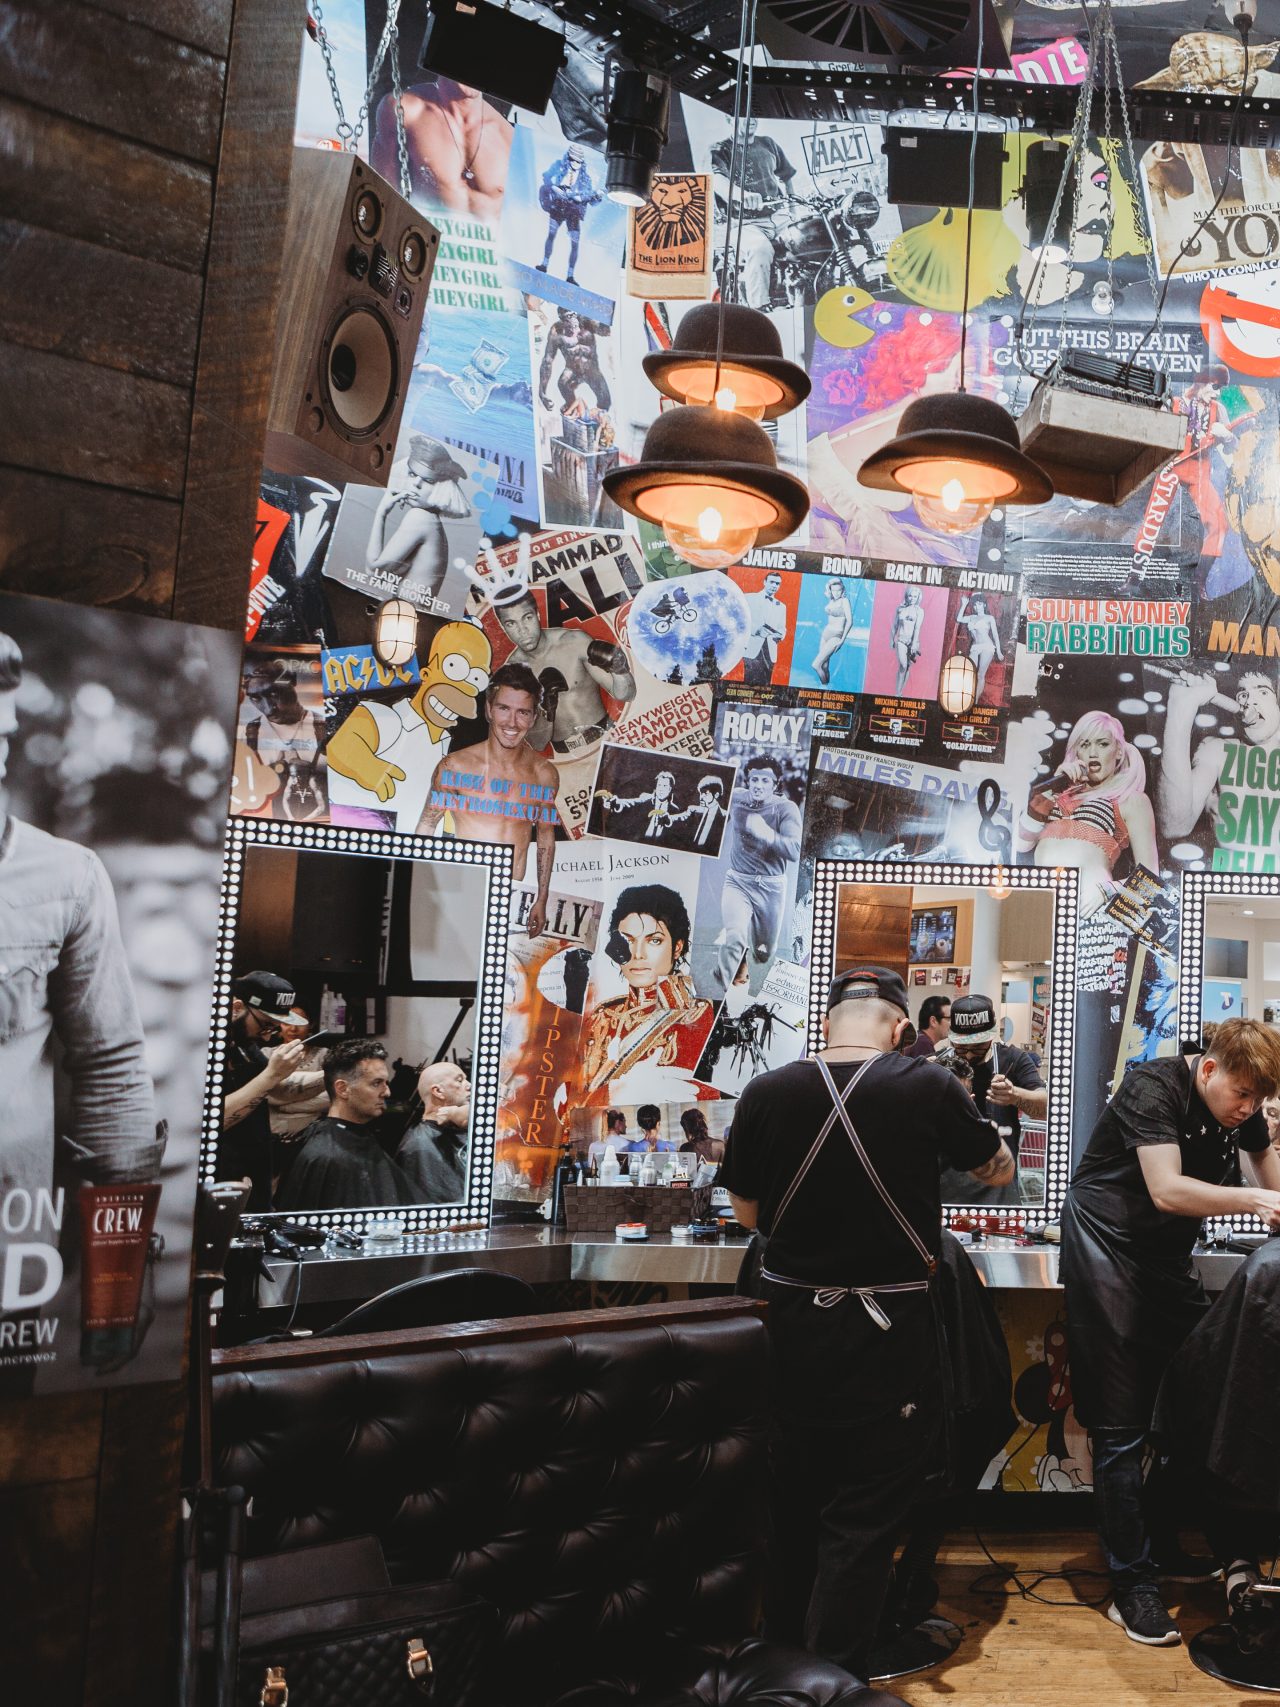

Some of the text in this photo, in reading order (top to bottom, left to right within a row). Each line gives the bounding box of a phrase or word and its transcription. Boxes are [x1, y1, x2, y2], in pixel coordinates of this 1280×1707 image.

[810, 134, 863, 168] HALT
[1218, 206, 1240, 216] THE
[1242, 203, 1276, 214] FORCE
[639, 253, 700, 266] THE LION KING
[1183, 273, 1211, 284] WHO
[1210, 269, 1226, 280] YA
[1228, 262, 1268, 276] GONNA
[1056, 329, 1191, 352] THIS BRAIN
[993, 347, 1062, 369] GOES
[1130, 469, 1179, 581] STARDUST
[374, 568, 432, 597] LADY GAGA
[743, 549, 1014, 591] JAMES BOND BACK IN ACTION!
[346, 568, 451, 613] THE FAME MONSTER
[545, 553, 644, 629] ALI
[1026, 598, 1192, 625] SOUTH SYDNEY
[1026, 622, 1191, 657] RABBITOHS
[799, 690, 855, 702] MIXING BUSINESS
[807, 700, 844, 709] AND GIRLS!
[874, 697, 926, 710] MIXING THRILLS
[610, 686, 699, 738] HEAVYWEIGHT
[617, 695, 707, 746] CHAMPION
[881, 707, 918, 718] AND GIRLS!
[968, 715, 991, 725] GIRLS!
[973, 708, 998, 717] DANGER
[645, 708, 712, 748] WORLD
[721, 710, 806, 744] ROCKY
[688, 737, 714, 758] BE
[870, 734, 924, 746] "GOLDFINGER"
[942, 741, 996, 754] "GOLDFINGER"
[822, 745, 865, 760] PHOTOGRAPHED
[865, 754, 873, 762] BY
[873, 756, 896, 767] FRANCIS
[819, 751, 913, 789] MILES
[440, 769, 486, 791] RISE
[489, 779, 515, 795] OF
[518, 781, 556, 802] THE
[430, 789, 561, 826] METROSEXUAL
[608, 853, 671, 874] JACKSON
[93, 1207, 143, 1234] CREW
